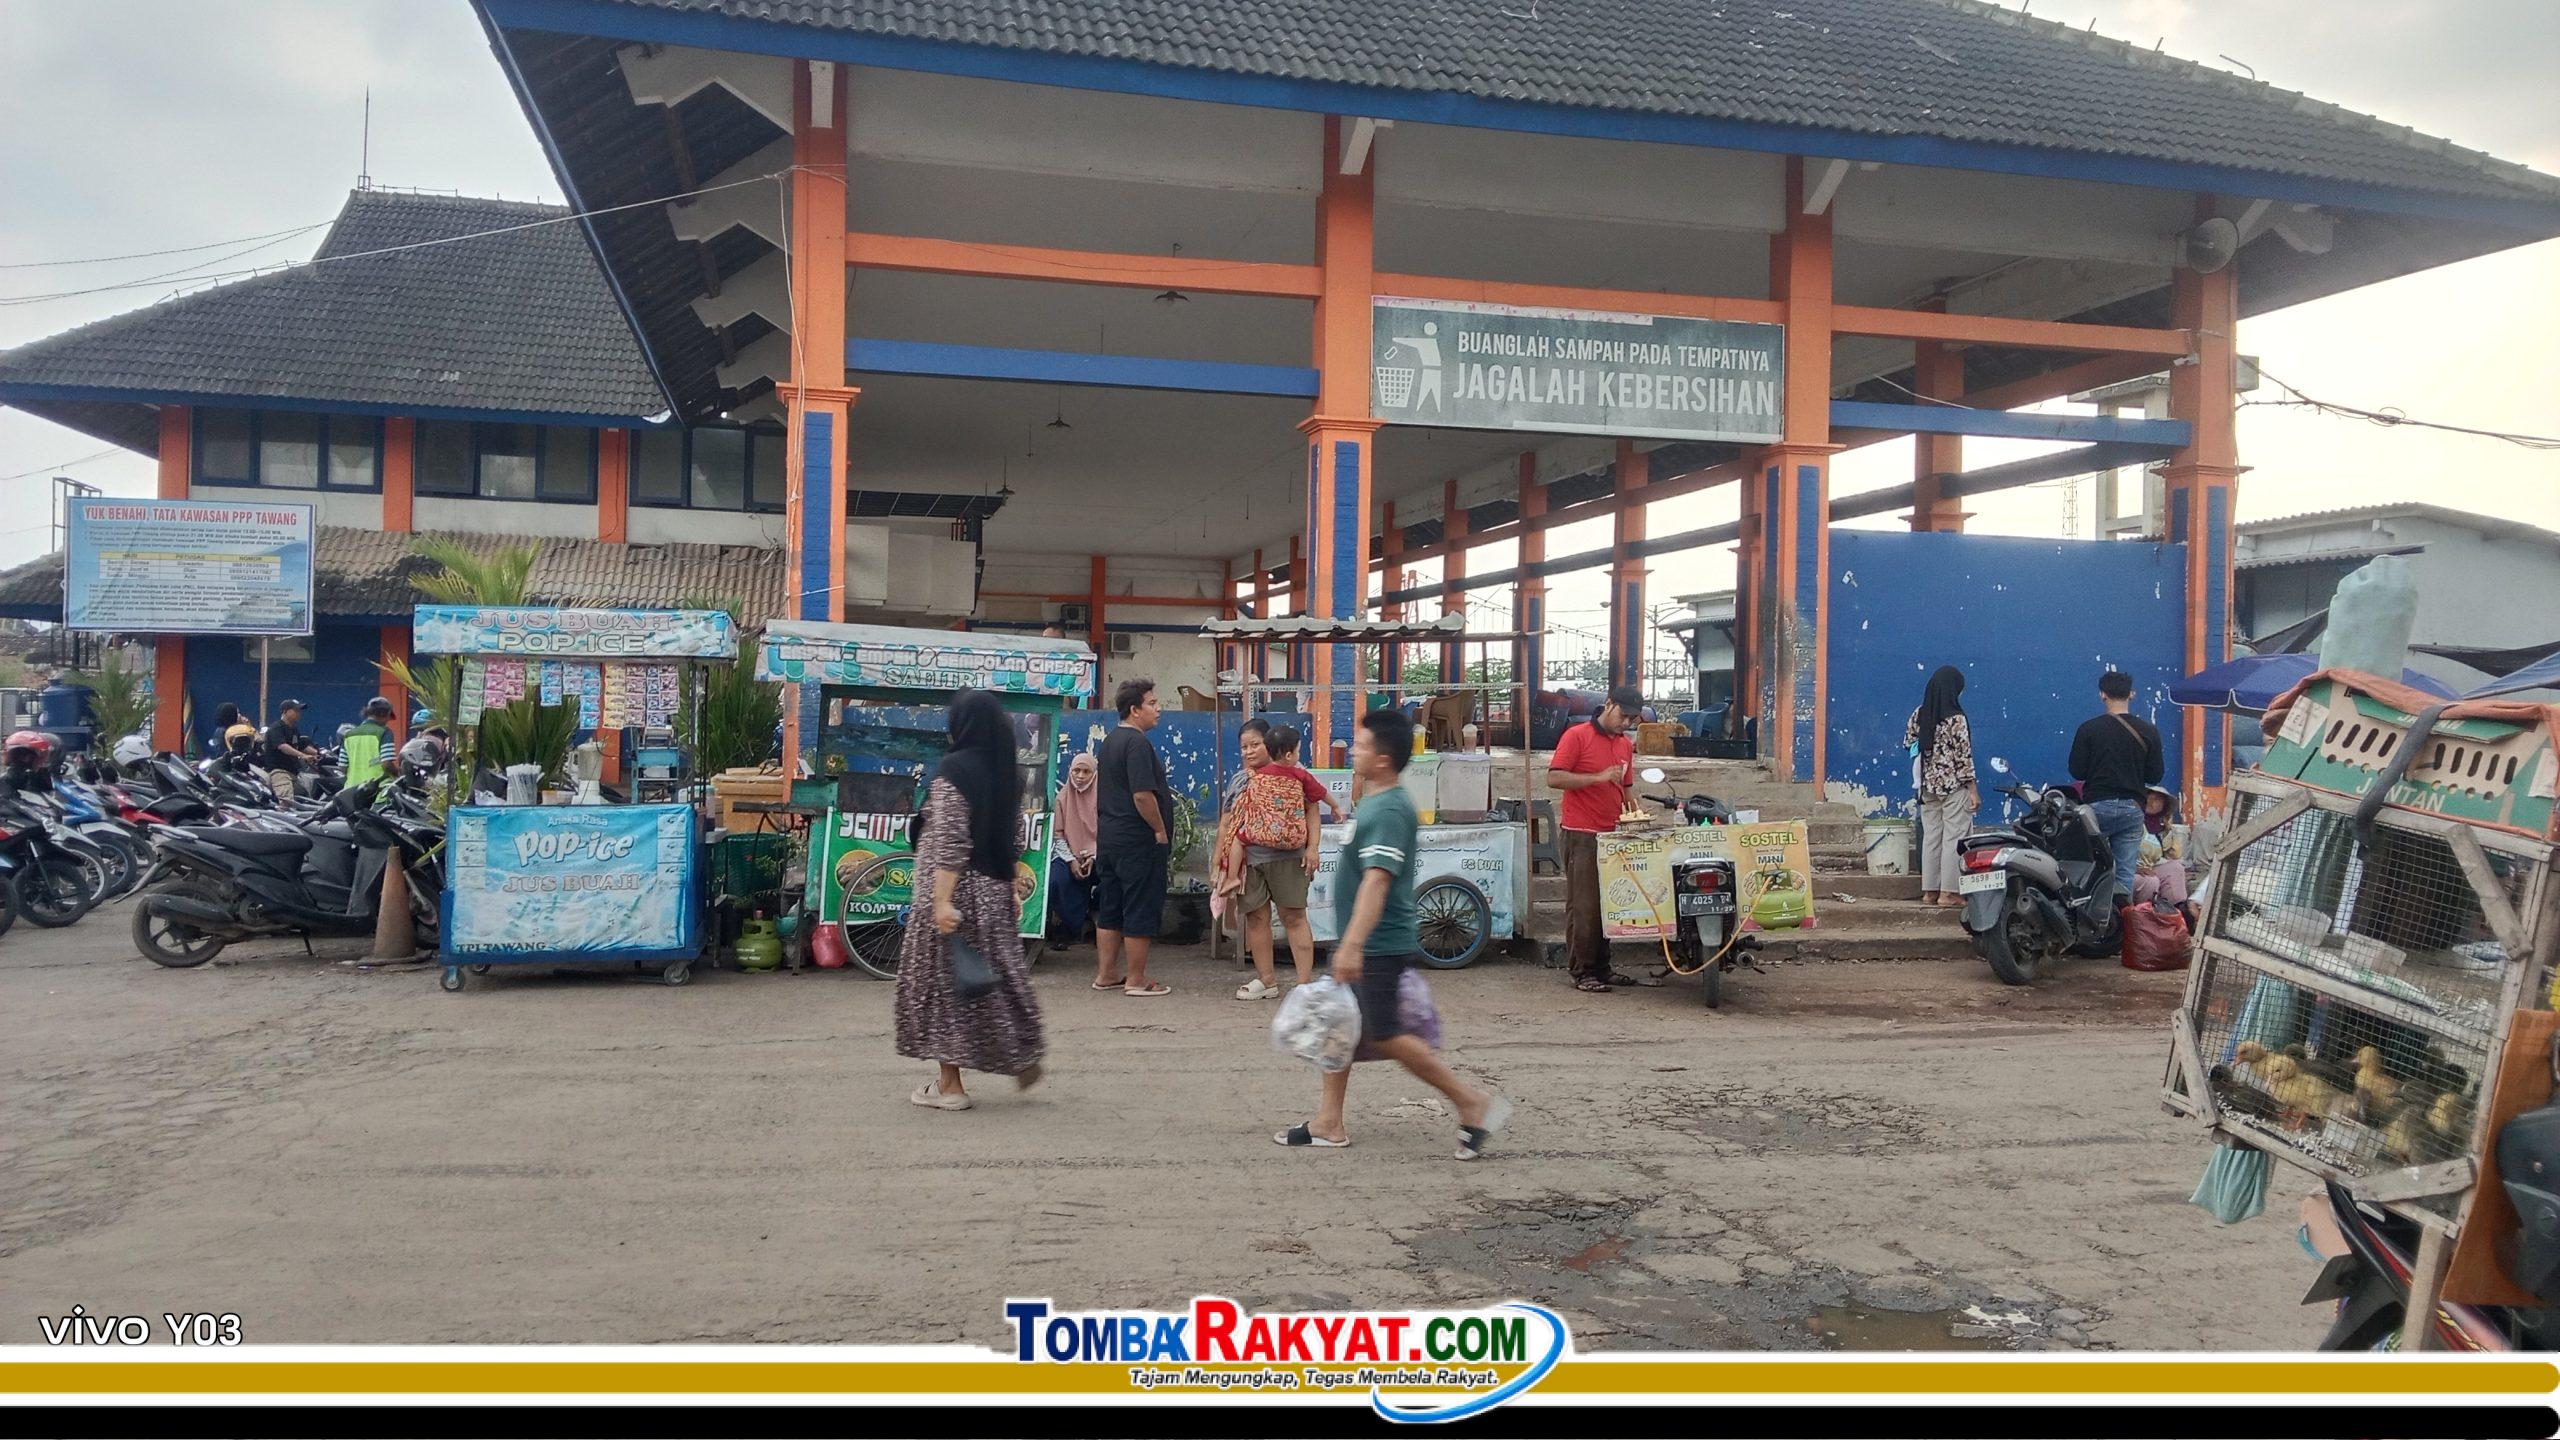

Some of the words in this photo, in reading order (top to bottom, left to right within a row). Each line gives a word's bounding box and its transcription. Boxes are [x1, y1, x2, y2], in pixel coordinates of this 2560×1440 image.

[1458, 331, 1550, 358] BUANGLAH
[1555, 338, 1625, 362] SAMPAH
[1630, 343, 1671, 365] PADA
[1678, 346, 1770, 372] TEMPATNYA
[1452, 363, 1586, 405] JAGALAH
[1598, 371, 1774, 416] KEBERSIHAN
[84, 507, 105, 520] YUK
[108, 507, 150, 522] BENAHI,
[153, 508, 177, 521] TATA
[180, 509, 229, 523] KAWASAN
[232, 511, 252, 524] PPP
[256, 512, 297, 525] TAWANG
[473, 610, 553, 630] JUS
[558, 611, 671, 631] BUAH
[497, 632, 575, 652] POP
[589, 633, 645, 652] ICE
[885, 668, 984, 689] SAFITRI
[2355, 777, 2446, 812] JNTAN
[1674, 830, 1727, 845] SOSTEL
[1740, 832, 1798, 848] SOSTEL
[502, 876, 559, 893] JUS
[562, 874, 641, 892] BUAH
[1692, 896, 1713, 905] 4025
[484, 941, 547, 952] TAWANG
